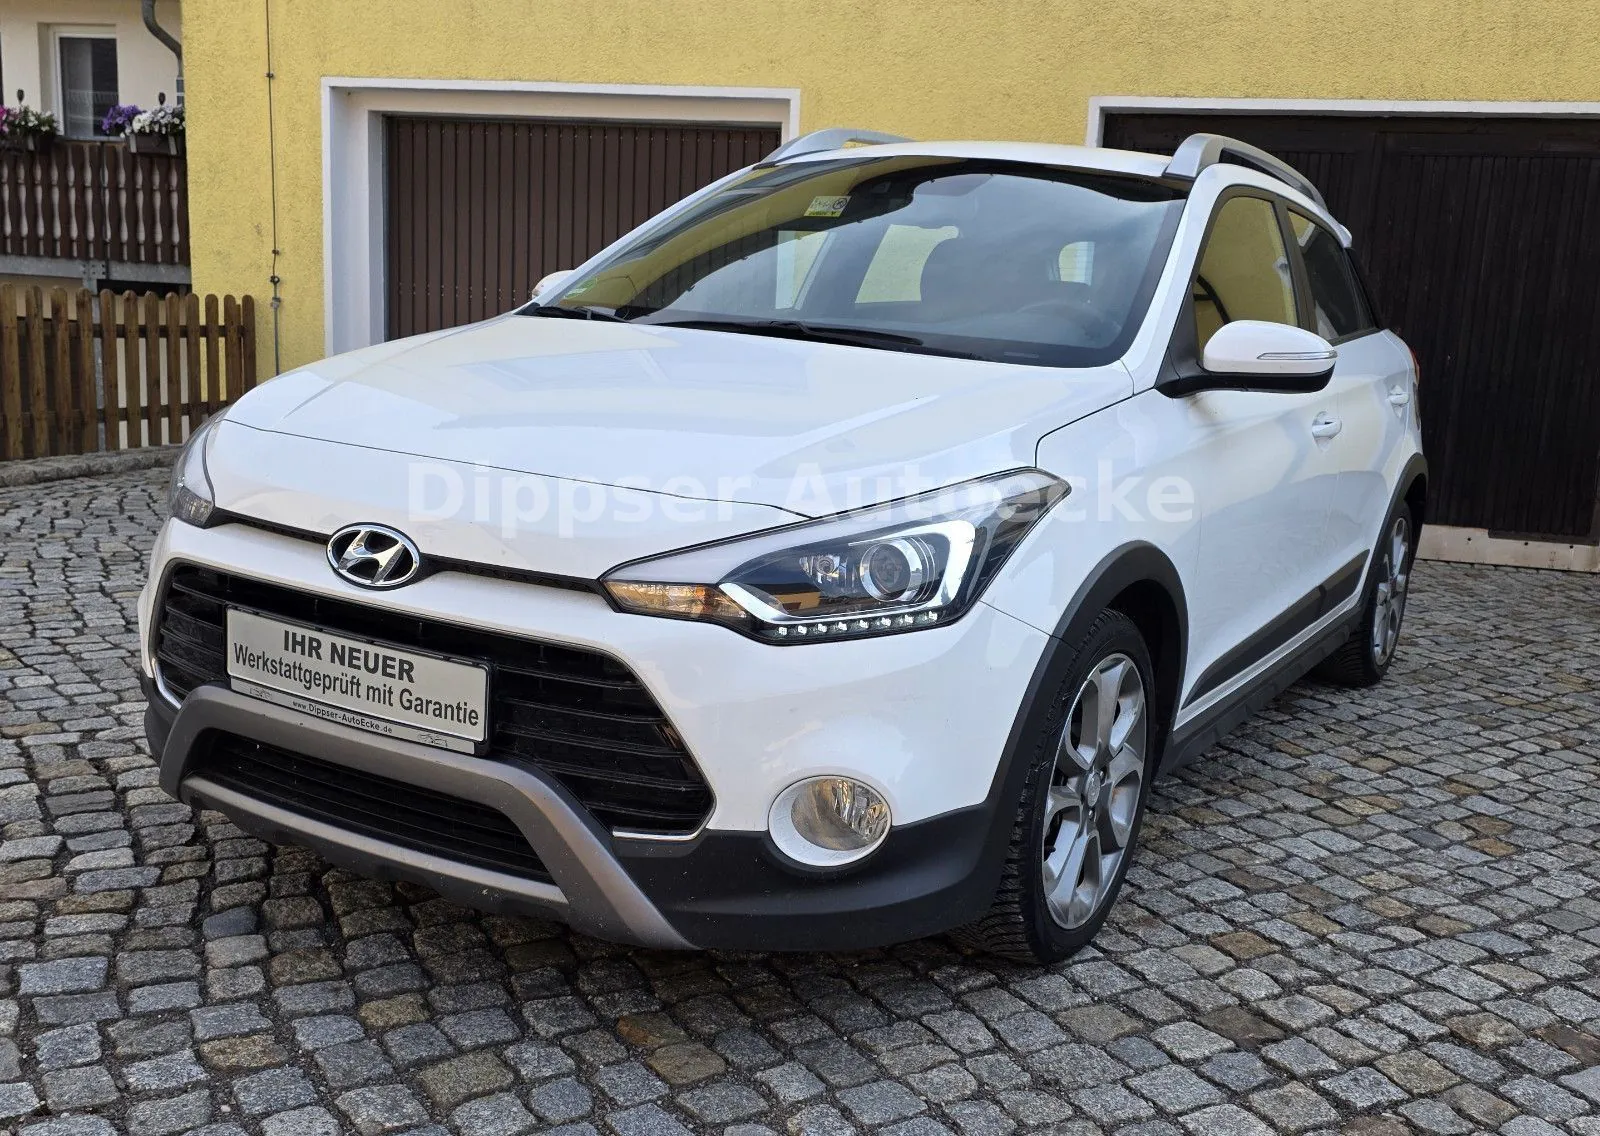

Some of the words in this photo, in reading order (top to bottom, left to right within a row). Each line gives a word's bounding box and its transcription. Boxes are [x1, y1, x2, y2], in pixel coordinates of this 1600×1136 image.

[283, 629, 323, 661] IHR
[330, 641, 415, 684] NEUER
[233, 642, 361, 700] Werkstattgeprüft
[366, 682, 394, 708] mit
[399, 687, 479, 727] Garantie
[292, 700, 393, 734] www.Dippser-AutoEcke.de
